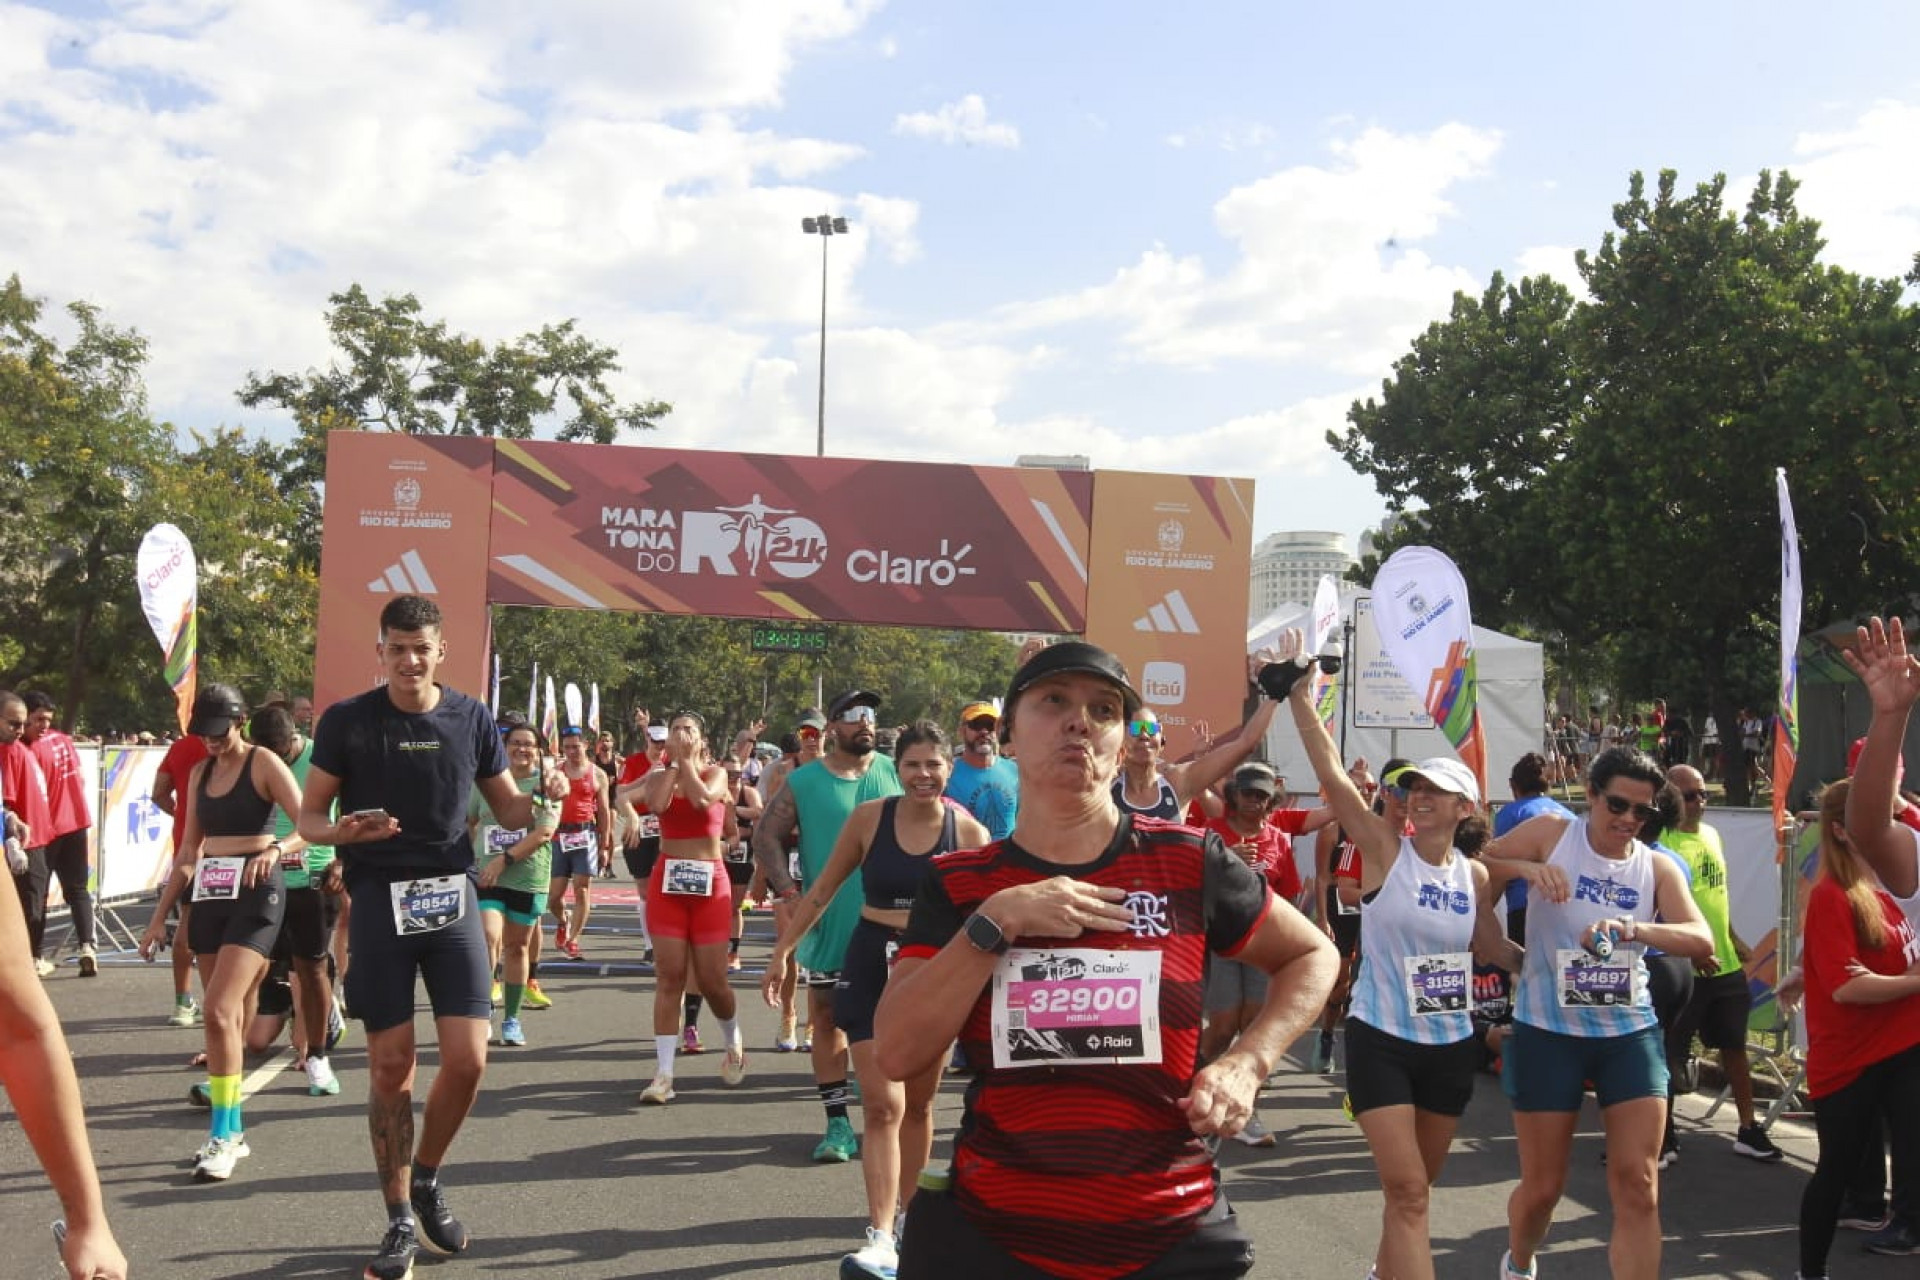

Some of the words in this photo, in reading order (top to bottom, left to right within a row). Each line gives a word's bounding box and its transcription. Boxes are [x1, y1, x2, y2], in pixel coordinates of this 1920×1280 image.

[361, 517, 382, 527] RIO
[384, 518, 399, 527] DE
[401, 519, 451, 528] JANEIRO
[602, 506, 676, 529] MARA
[605, 528, 674, 550] TONA
[147, 553, 182, 589] Claro
[637, 552, 675, 573] DO
[847, 548, 956, 586] Claro
[1126, 556, 1146, 566] RIO
[1148, 557, 1163, 567] DE
[1165, 559, 1213, 569] JANEIRO
[1145, 678, 1181, 696] itaú
[1093, 964, 1124, 973] Claro
[1029, 986, 1138, 1013] 32900
[1103, 1035, 1132, 1048] Raia
